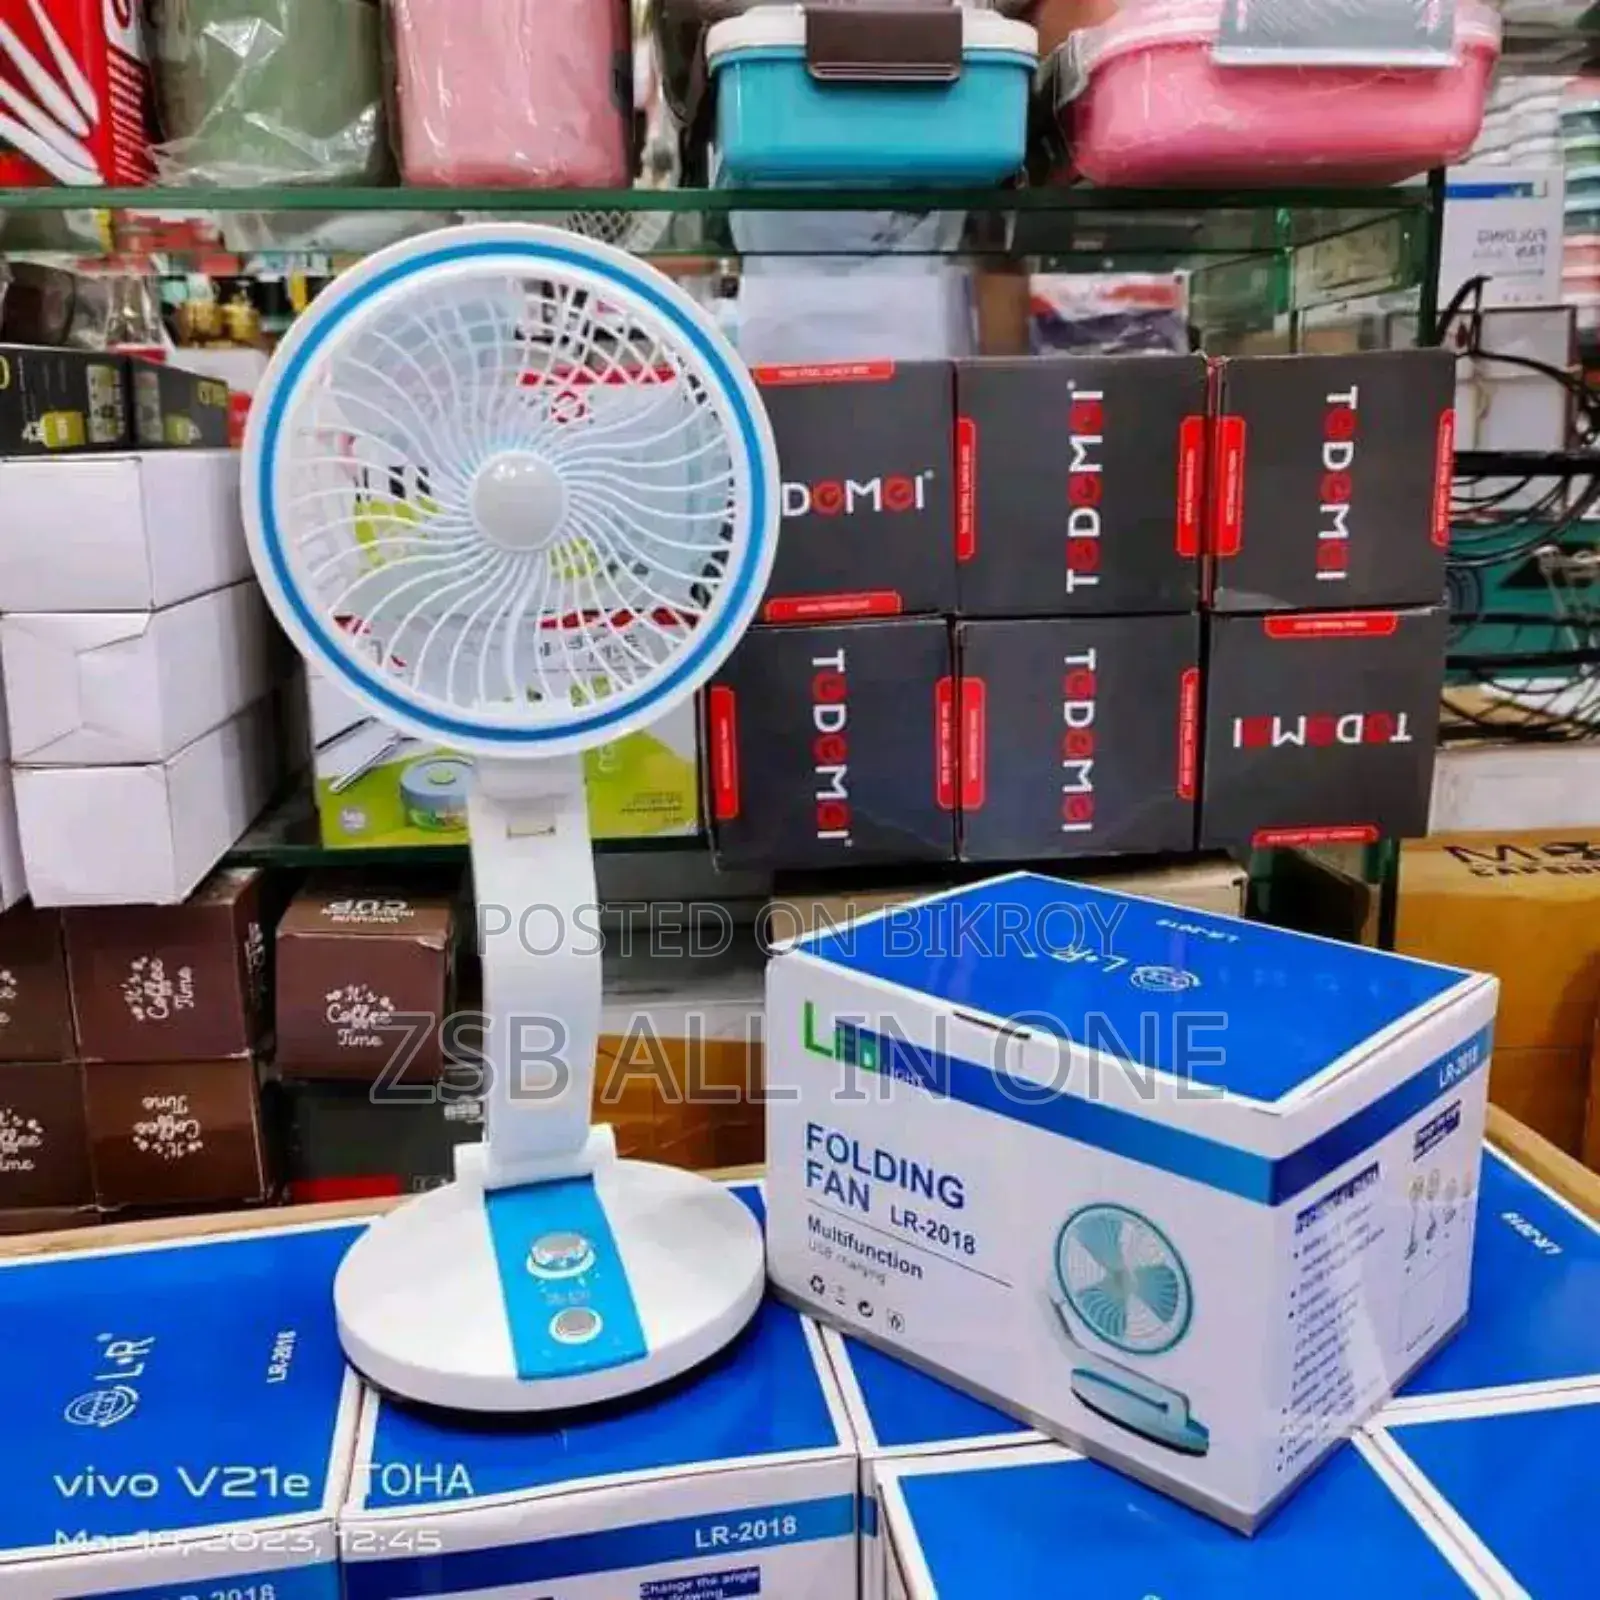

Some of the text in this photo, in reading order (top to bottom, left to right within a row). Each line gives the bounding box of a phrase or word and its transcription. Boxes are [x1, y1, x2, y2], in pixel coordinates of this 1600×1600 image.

[326, 1002, 392, 1030] Coffee
[337, 1028, 384, 1047] Time
[0, 1153, 36, 1172] ime
[806, 1121, 965, 1210] FOLDING
[805, 1160, 976, 1255] FAN LR-2018
[807, 1214, 923, 1279] Multifunction
[694, 1514, 798, 1549] LR-2018
[640, 1568, 760, 1597] Change the angle
